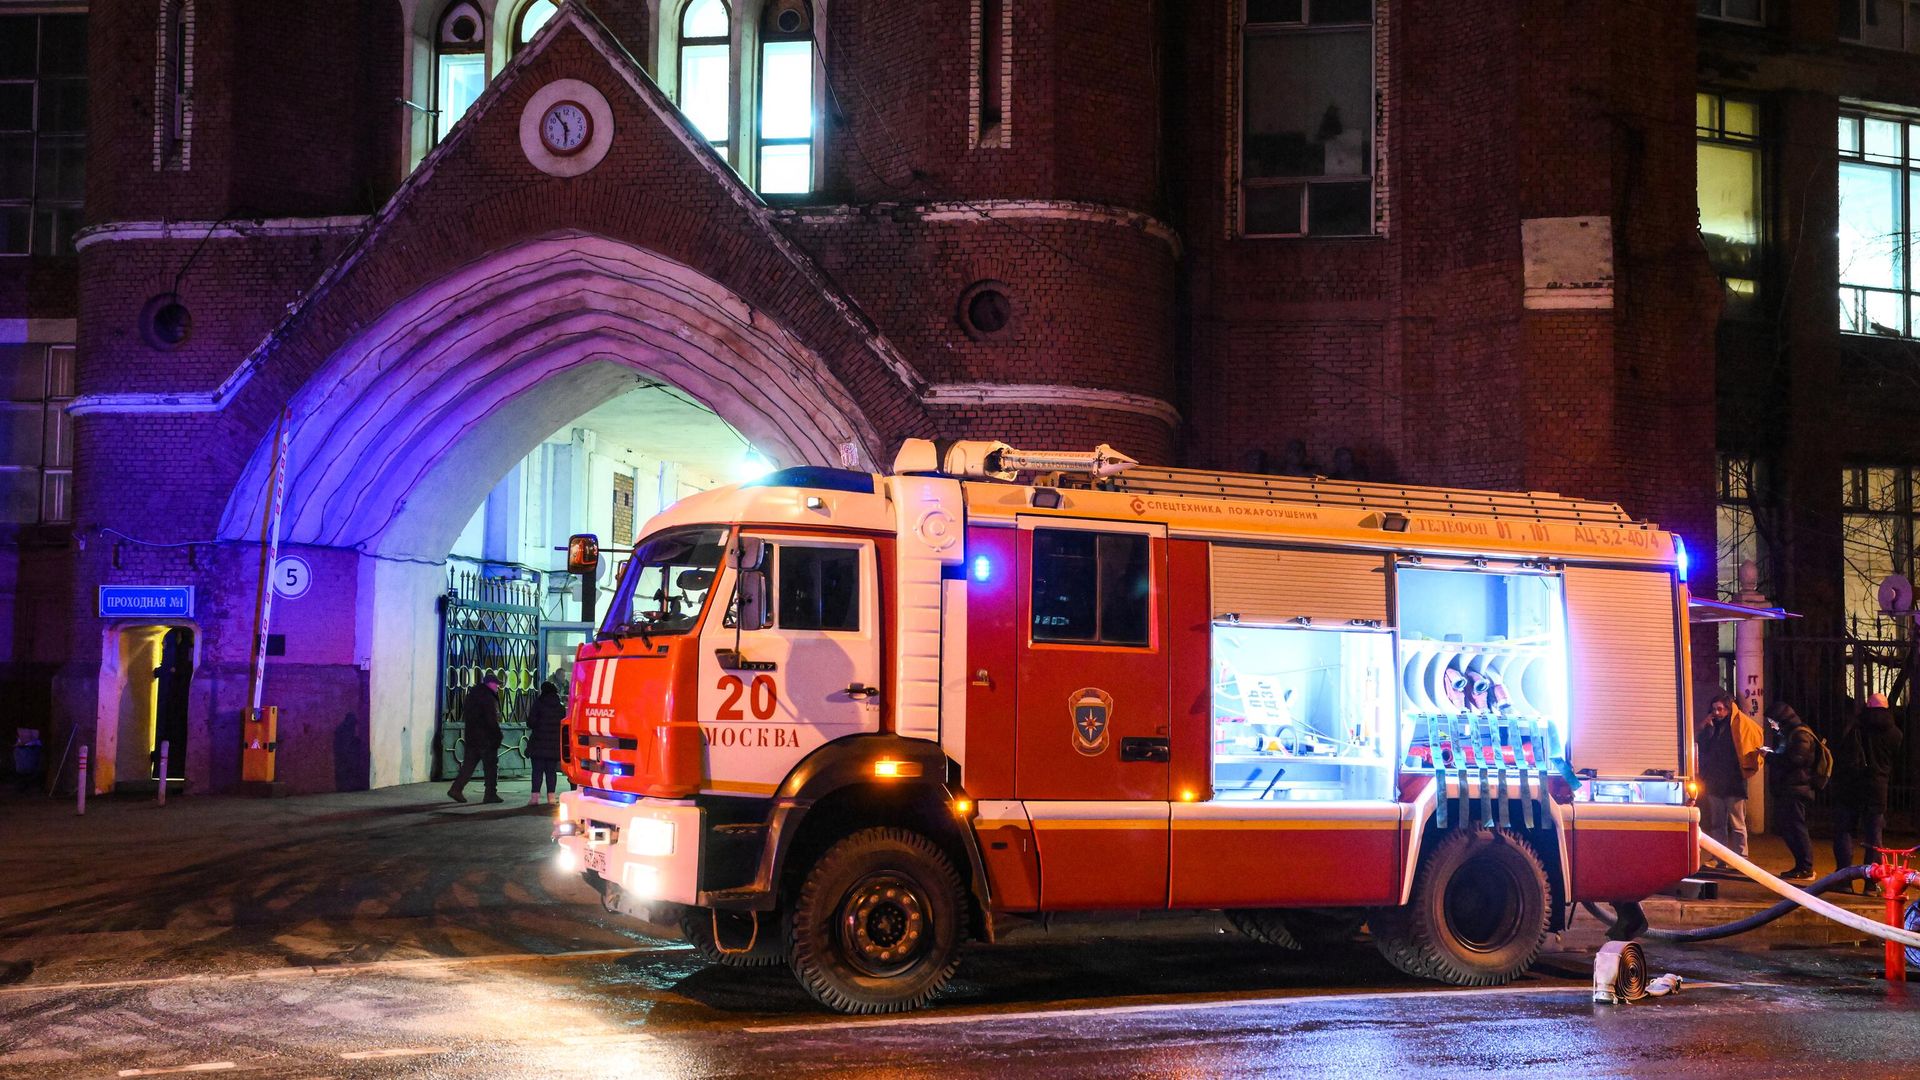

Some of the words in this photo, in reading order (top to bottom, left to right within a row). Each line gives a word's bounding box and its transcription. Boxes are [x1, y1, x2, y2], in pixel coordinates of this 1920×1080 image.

[1147, 500, 1222, 514] СПЕЦТЕХНИКА
[1228, 506, 1319, 520] ПОЖАРОТУШЕНИЯ
[1417, 518, 1488, 535] ТЕЛЕФОН
[1496, 521, 1512, 539] 01
[1574, 526, 1660, 549] АЦ-3,2-40/4
[286, 568, 298, 587] 5
[107, 596, 167, 608] ПРОХОДНАЯ
[169, 597, 184, 608] №1
[716, 674, 778, 720] 20
[585, 708, 615, 718] KAMAZ
[704, 727, 800, 747] МОСКВА
